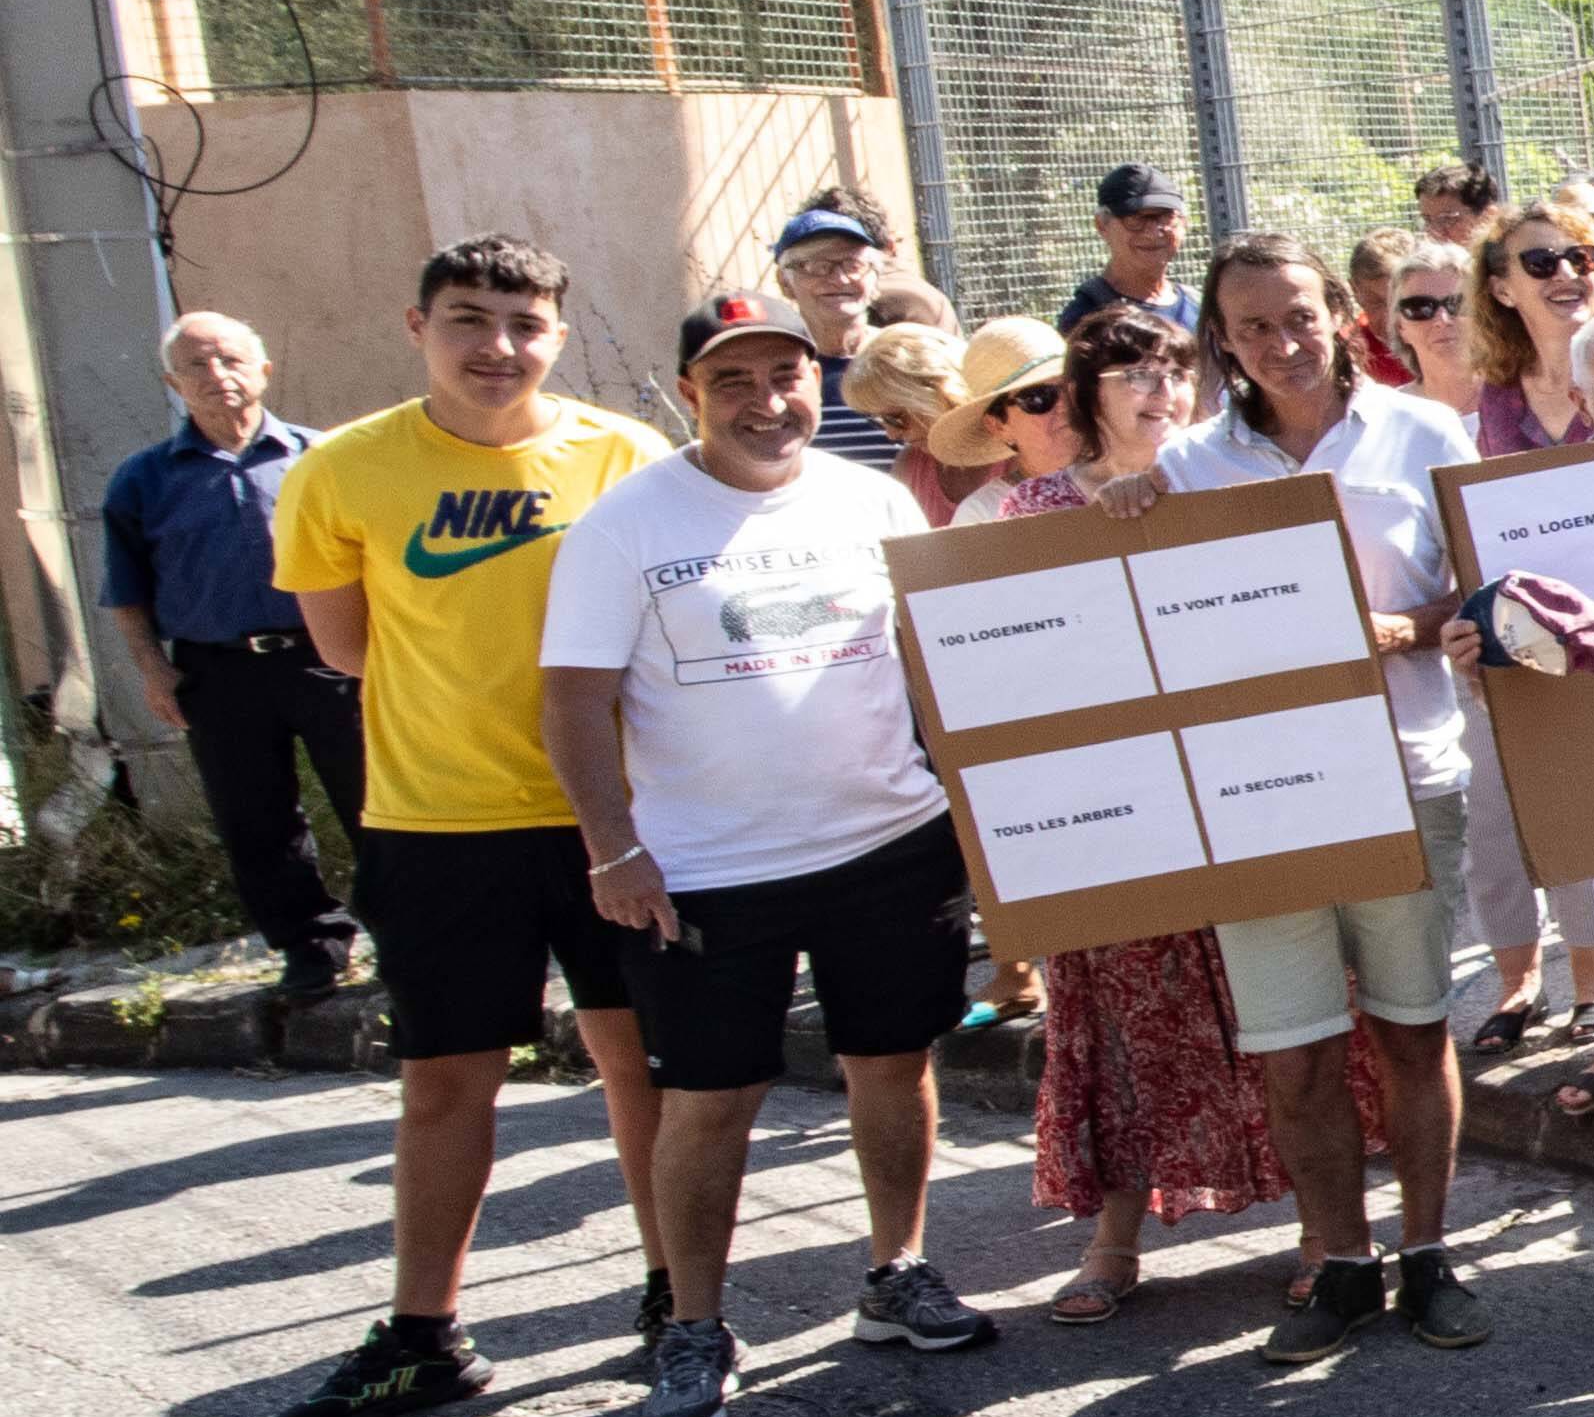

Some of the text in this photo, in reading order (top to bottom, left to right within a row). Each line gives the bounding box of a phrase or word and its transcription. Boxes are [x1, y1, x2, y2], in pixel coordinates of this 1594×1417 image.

[428, 489, 552, 539] NIKE
[1499, 527, 1529, 542] 100
[656, 554, 772, 585] CHEMISE
[1157, 583, 1300, 616] ILS VONT ABATTRE
[938, 634, 965, 647] 100
[969, 617, 1066, 642] LOGEMENTS
[725, 658, 777, 675] MADE
[821, 643, 872, 663] FRANCE
[1220, 785, 1240, 797] AU
[1244, 773, 1315, 792] SECOURS
[992, 805, 1134, 838] TOUS LES ARBRES
